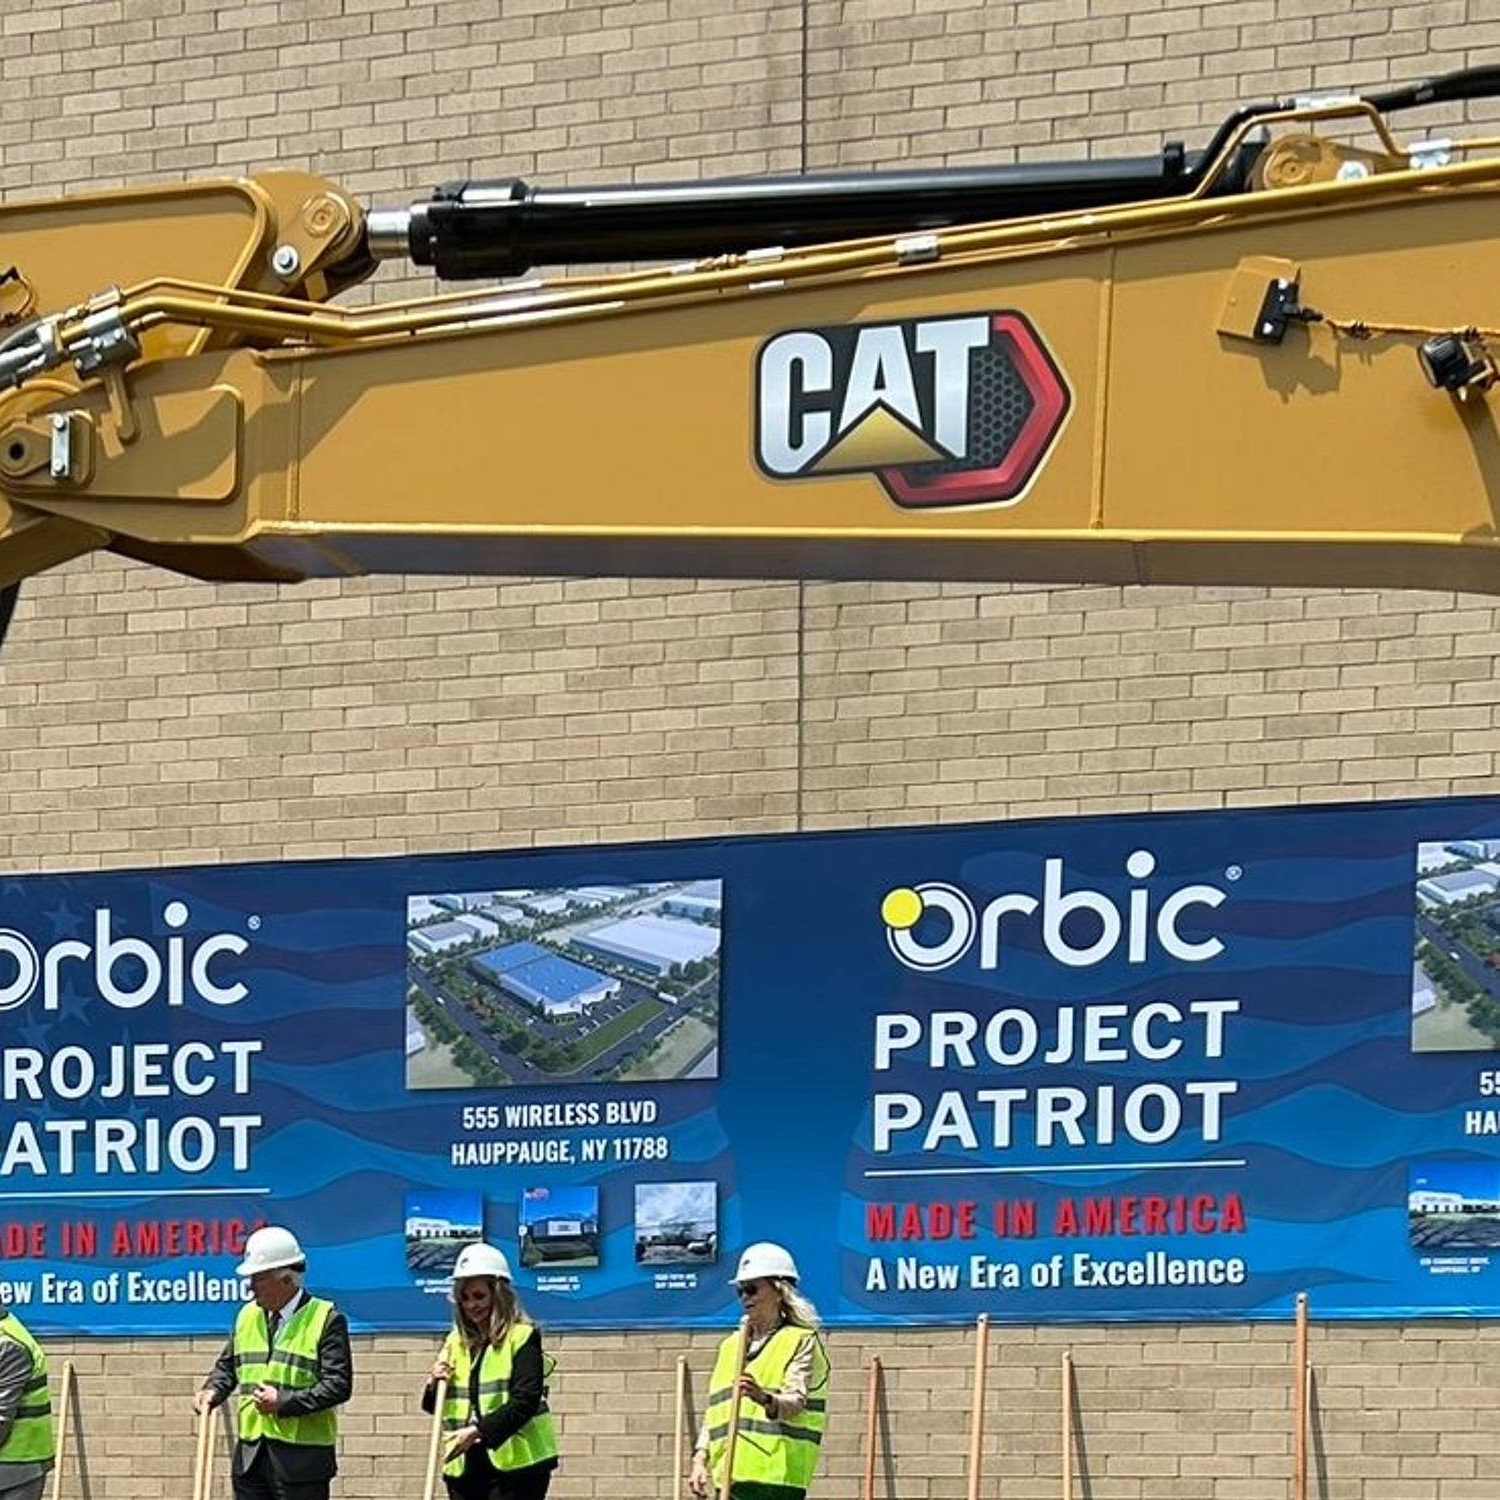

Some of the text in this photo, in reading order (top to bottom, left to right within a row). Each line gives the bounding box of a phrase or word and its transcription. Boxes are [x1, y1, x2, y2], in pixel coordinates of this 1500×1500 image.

[759, 317, 991, 474] CAT
[874, 1000, 1240, 1071] PROJECT
[463, 1100, 657, 1129] 555 WIRELESS BLVD
[873, 1081, 1239, 1152] PATRIOT
[452, 1136, 669, 1165] HAUPPAUGE, NY 11788
[61, 1220, 97, 1256] IN
[110, 1217, 267, 1256] AMERIC
[865, 1193, 1246, 1240] MADE IN AMERICA
[0, 1270, 255, 1304] ew Era of Excellenc
[866, 1251, 1245, 1291] A New Era of Excellence
